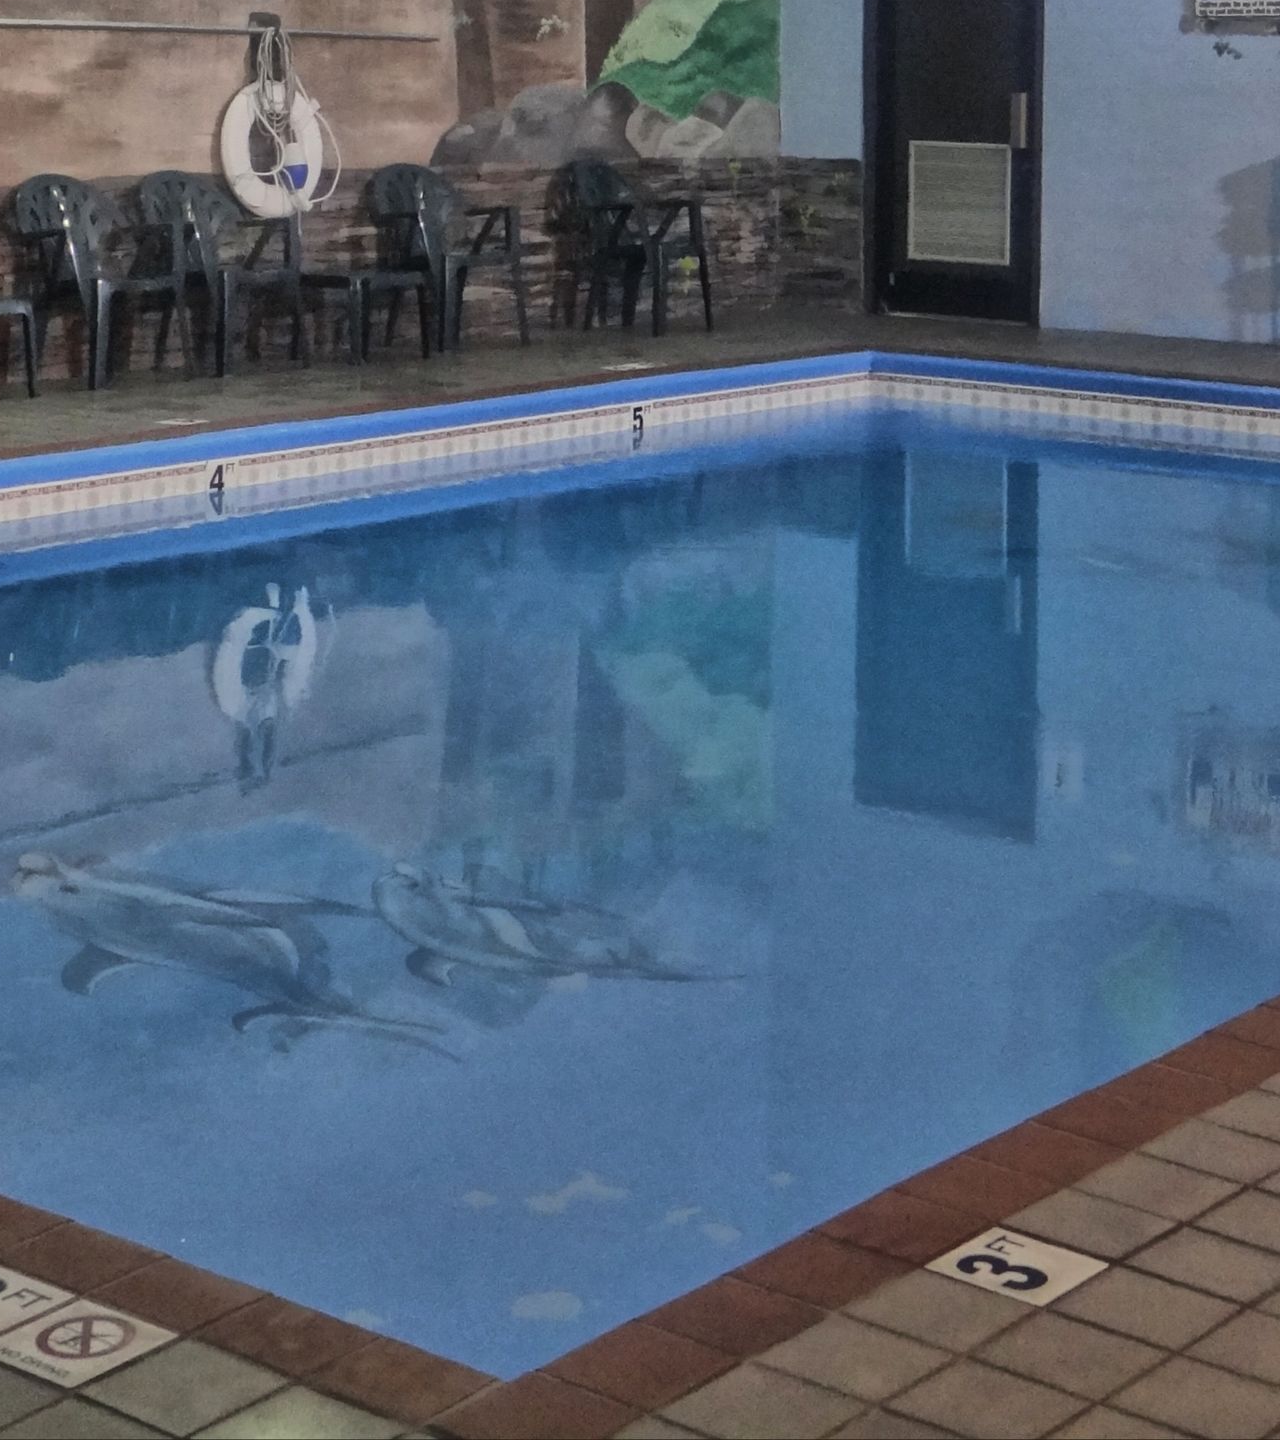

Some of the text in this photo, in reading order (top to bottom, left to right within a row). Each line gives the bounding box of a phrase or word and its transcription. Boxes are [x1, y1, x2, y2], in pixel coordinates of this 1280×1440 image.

[633, 406, 644, 432] 5
[209, 462, 236, 491] 4 FT
[956, 1235, 1049, 1291] 3 FT
[0, 1287, 53, 1311] FT
